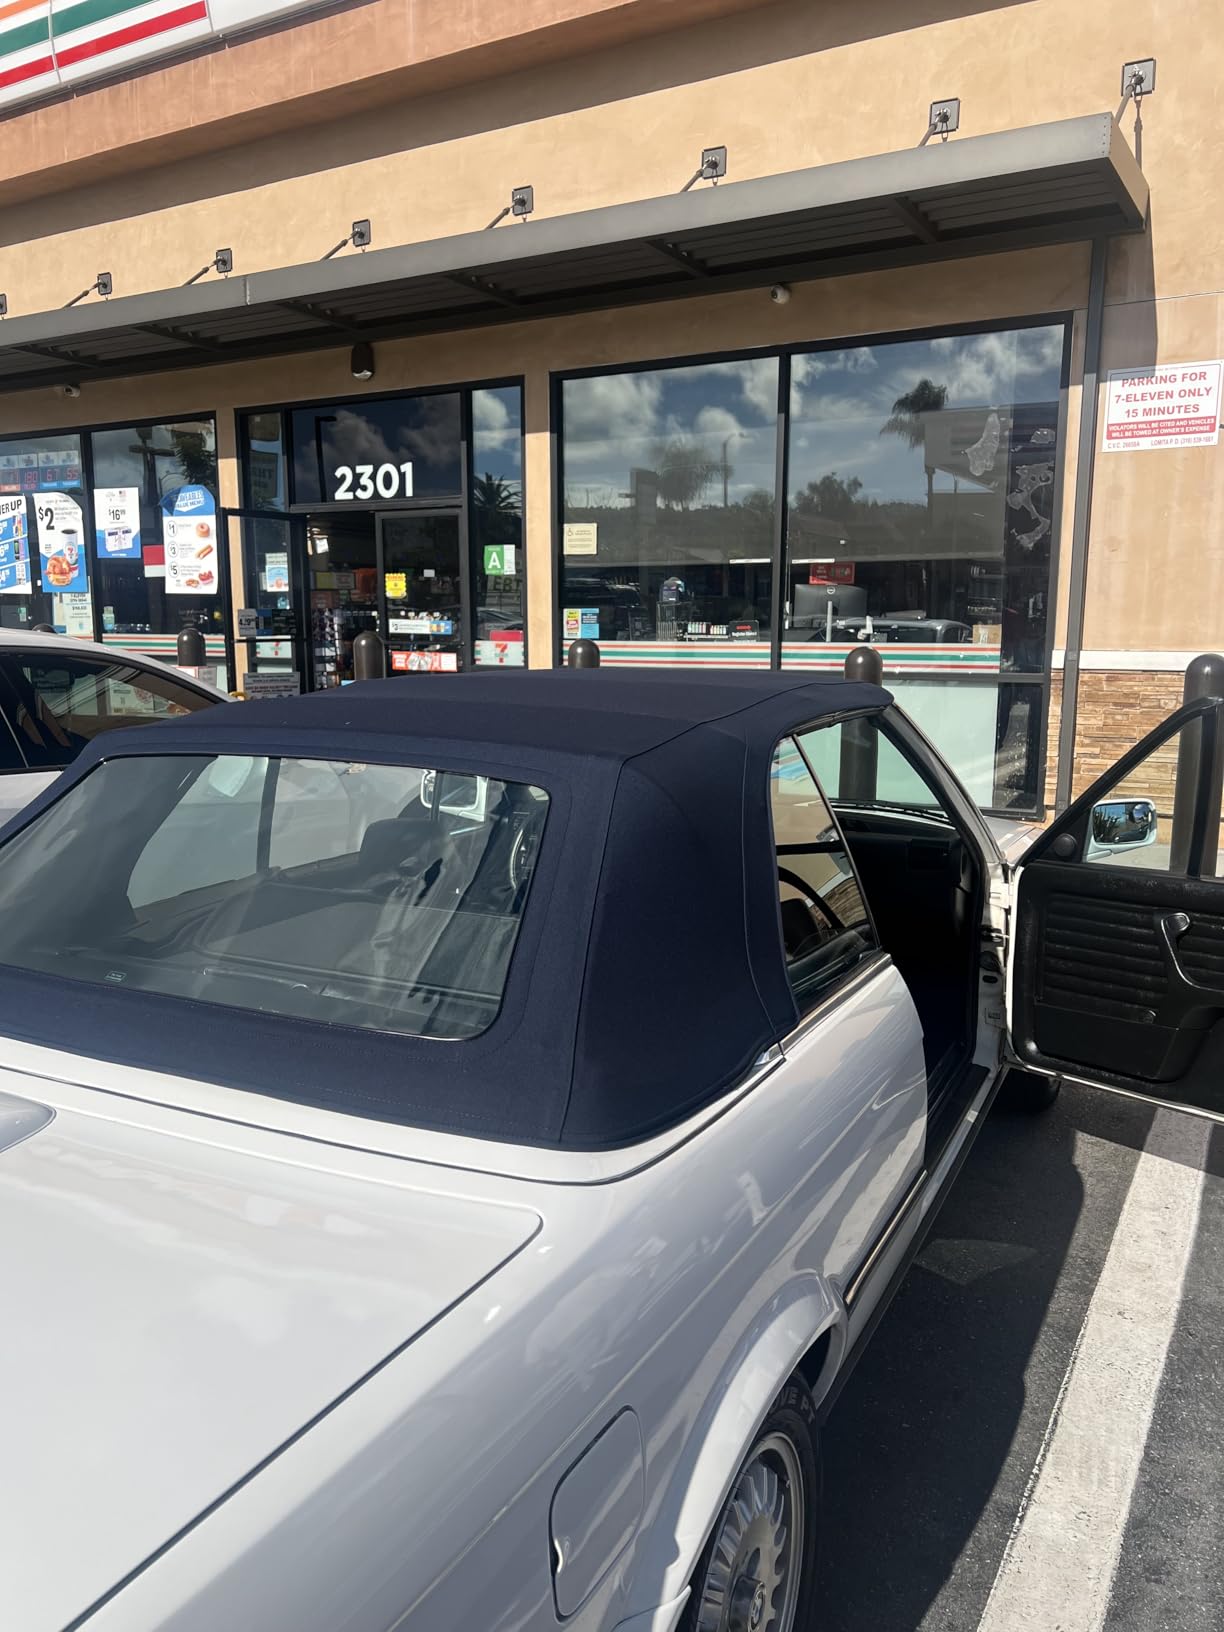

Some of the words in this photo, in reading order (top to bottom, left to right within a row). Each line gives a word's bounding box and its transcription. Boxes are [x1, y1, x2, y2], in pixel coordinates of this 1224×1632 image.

[1121, 374, 1177, 388] PARKING
[1181, 371, 1207, 382] FOR
[1114, 390, 1174, 404] 7-ELEVEN
[1178, 386, 1213, 398] ONLY
[1125, 408, 1139, 418] 15
[1142, 403, 1200, 417] MINUTES
[1108, 423, 1137, 431] VIOLATORS
[1188, 417, 1214, 425] VEHICLES
[1185, 425, 1210, 433] EXPENSE
[334, 461, 414, 501] 2301
[10, 499, 23, 511] UP
[38, 505, 55, 531] $2
[488, 551, 502, 569] A
